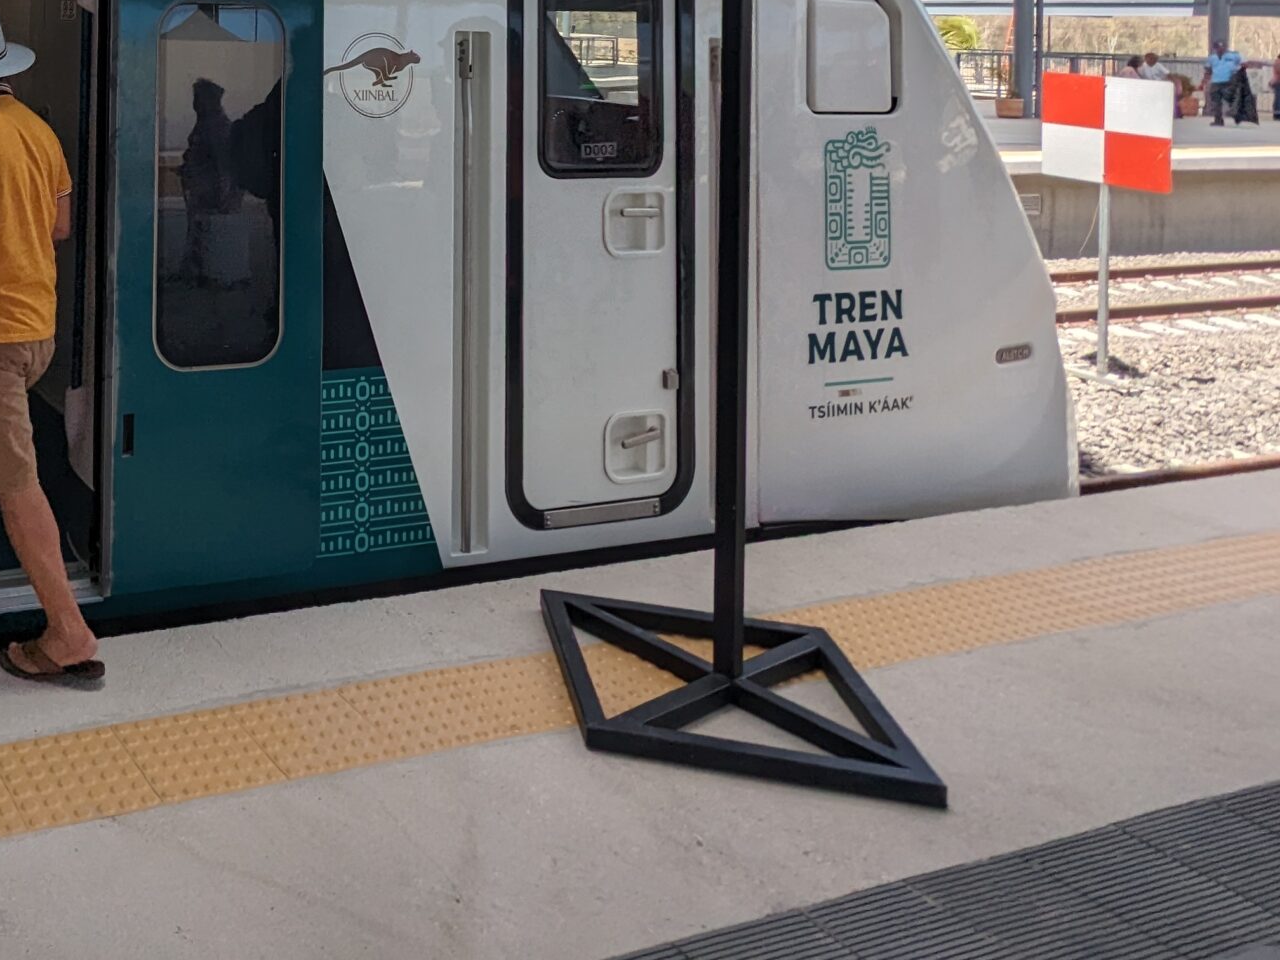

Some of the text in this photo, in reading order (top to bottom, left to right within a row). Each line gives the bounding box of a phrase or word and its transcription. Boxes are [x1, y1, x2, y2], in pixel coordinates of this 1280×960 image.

[353, 89, 397, 101] XIINBAL
[812, 289, 903, 325] TREN
[807, 327, 909, 365] MAYA
[808, 401, 863, 419] TSÍIMIN
